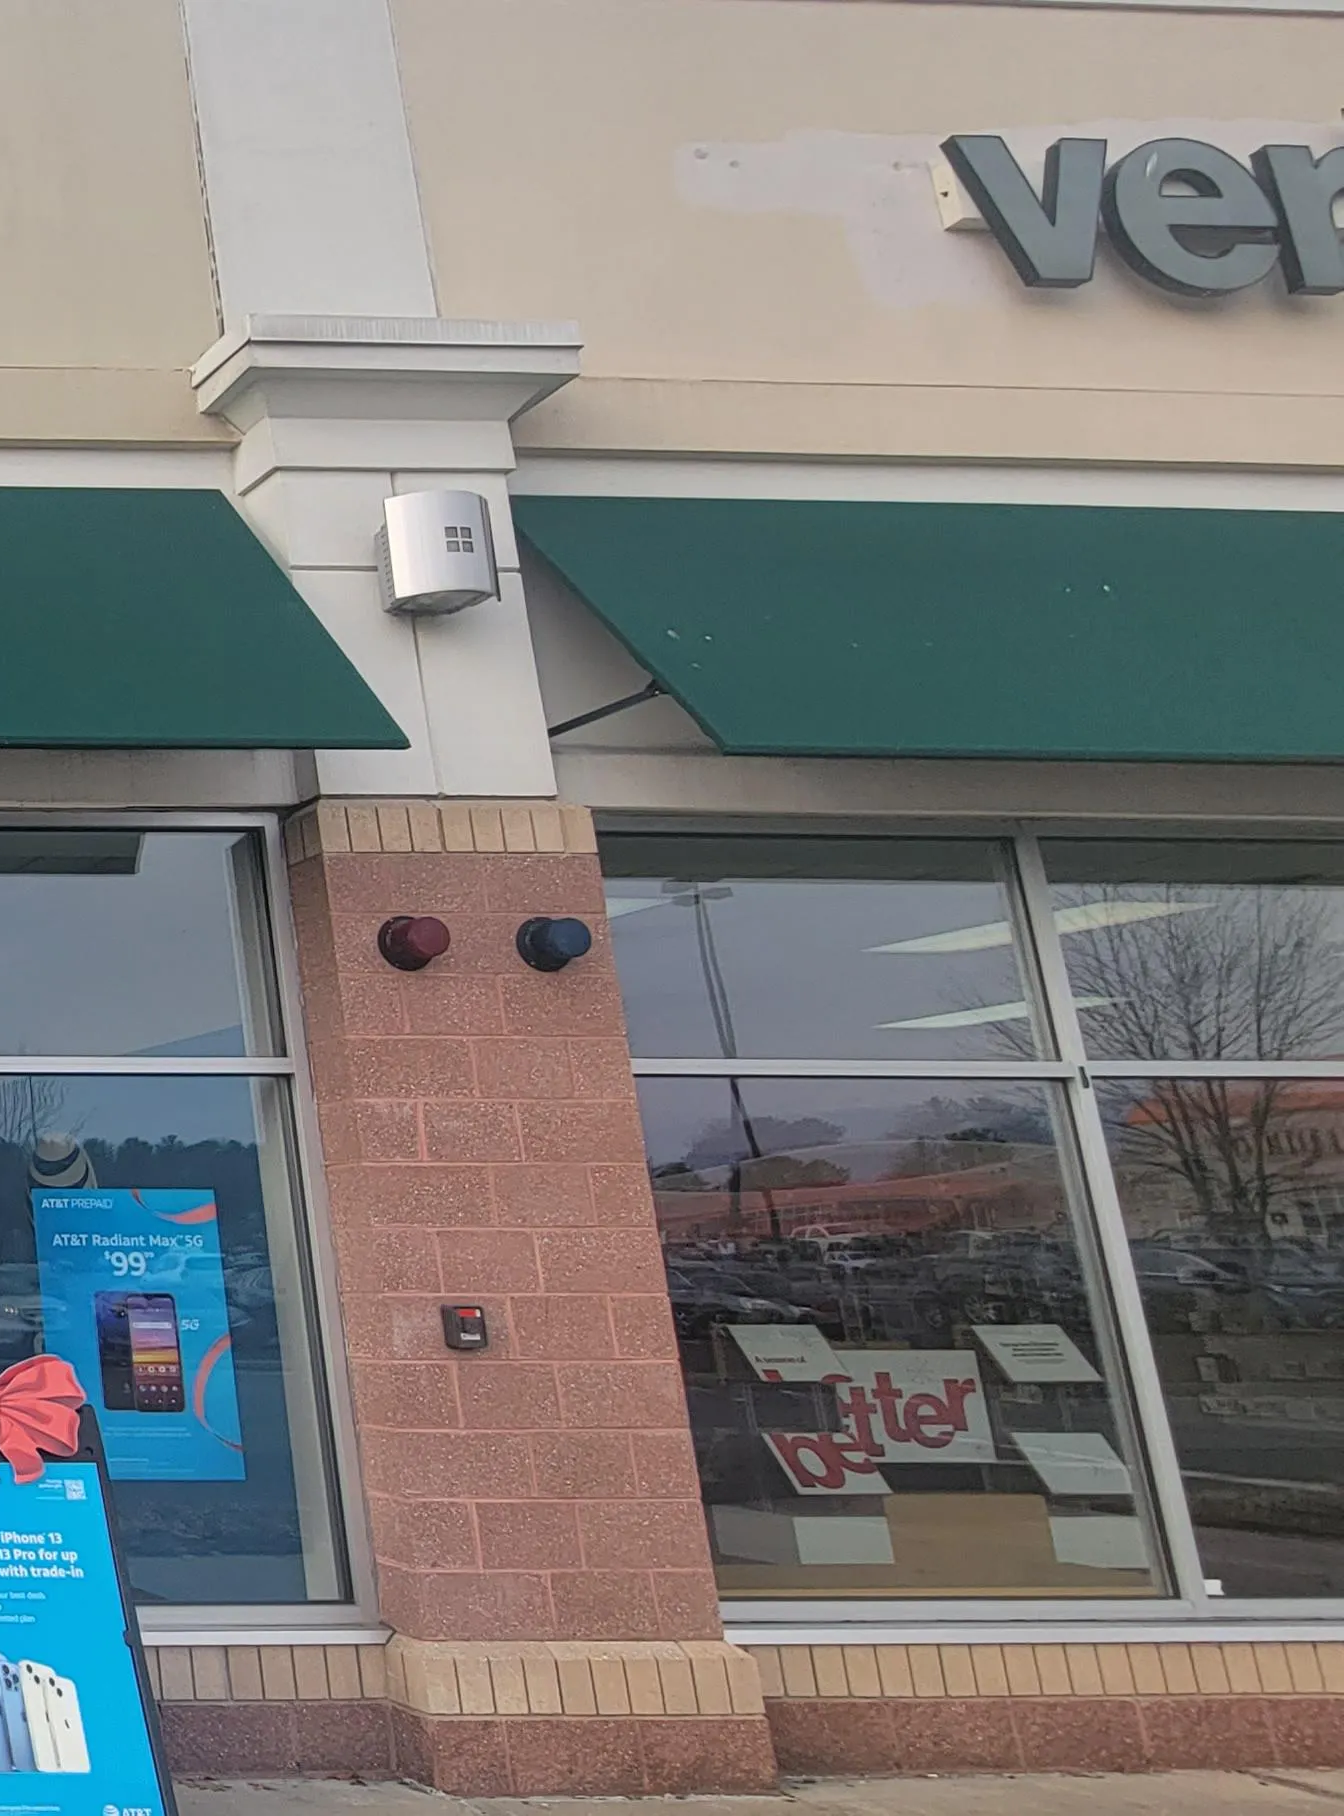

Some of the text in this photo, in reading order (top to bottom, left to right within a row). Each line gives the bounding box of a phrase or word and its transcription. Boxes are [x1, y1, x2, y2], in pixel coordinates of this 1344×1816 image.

[42, 1199, 113, 1209] AT&T PREPAID
[53, 1234, 88, 1247] AT&T
[92, 1234, 146, 1247] Radiant
[185, 1235, 203, 1247] 5G
[0, 1531, 45, 1544] iPhone
[48, 1532, 62, 1544] 13
[13, 1549, 36, 1561] Pro
[38, 1549, 58, 1561] for
[61, 1552, 78, 1564] up
[30, 1565, 84, 1578] trade-in
[122, 1808, 151, 1816] AT&T
